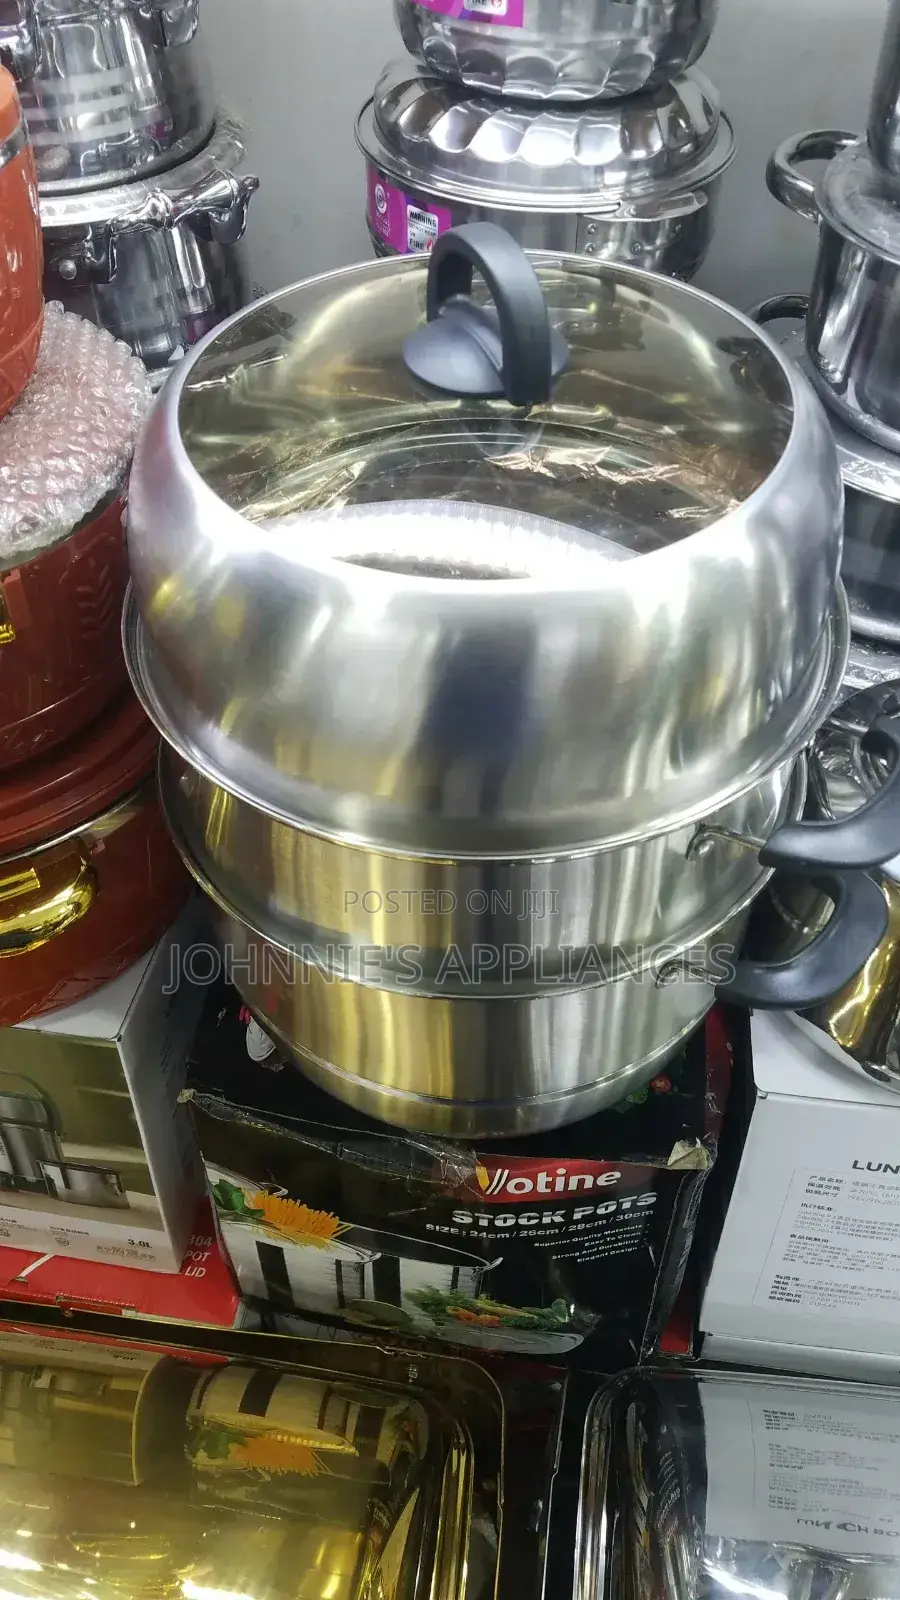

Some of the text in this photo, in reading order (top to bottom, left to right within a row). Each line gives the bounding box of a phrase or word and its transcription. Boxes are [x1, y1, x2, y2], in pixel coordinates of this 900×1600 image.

[409, 211, 436, 227] WARNING
[409, 238, 424, 250] FIRE
[852, 1160, 900, 1174] LUN
[475, 1167, 622, 1195] Votine
[452, 1191, 658, 1227] STOCK POTS
[469, 1230, 510, 1239] 24cm
[519, 1228, 559, 1237] 26cm
[568, 1219, 607, 1232] 28cm
[615, 1209, 654, 1222] 30cm
[188, 1234, 213, 1247] 304
[533, 1223, 643, 1247] Superior Quality Materials
[584, 1239, 605, 1247] Easy
[617, 1230, 641, 1239] Clean
[185, 1249, 211, 1262] POT
[552, 1251, 580, 1260] Strong
[581, 1246, 598, 1255] And
[609, 1245, 638, 1255] Design
[184, 1265, 207, 1278] LID
